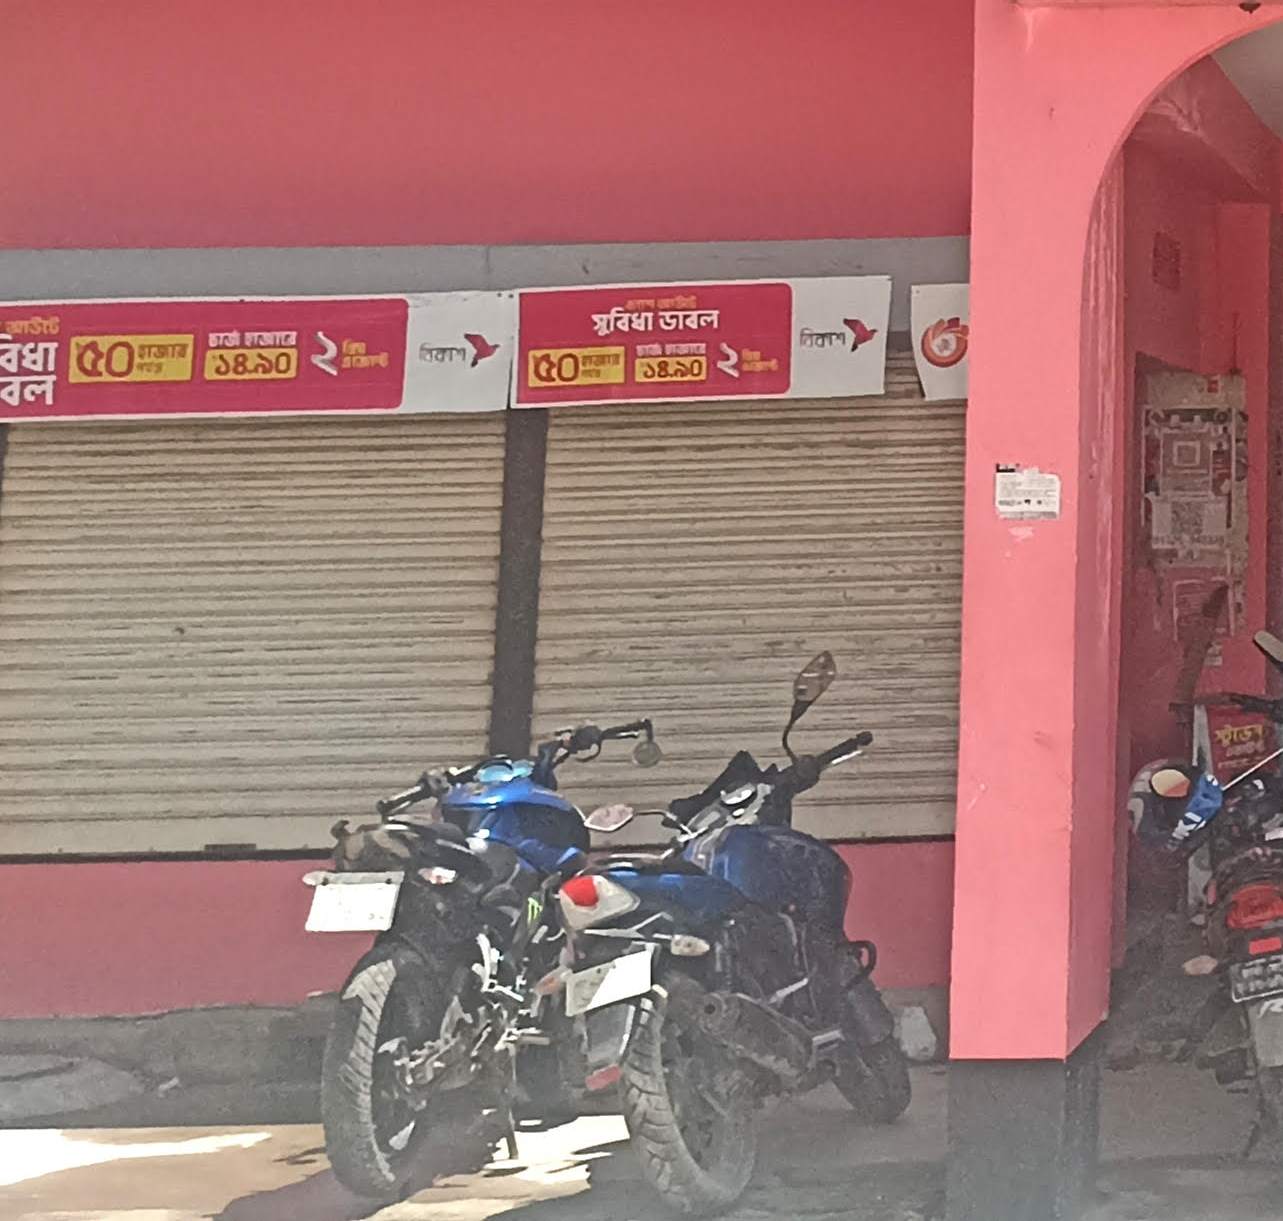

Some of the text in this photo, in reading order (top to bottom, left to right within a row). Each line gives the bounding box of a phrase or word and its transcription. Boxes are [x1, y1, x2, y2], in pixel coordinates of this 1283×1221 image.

[591, 307, 720, 336] সুবিধা ডাবল
[0, 333, 58, 373] বিধা
[75, 340, 135, 377] ৫০
[311, 331, 338, 376] ২
[533, 353, 579, 383] ৫০
[643, 359, 703, 379] ১৪.৯০
[0, 375, 57, 406] বল
